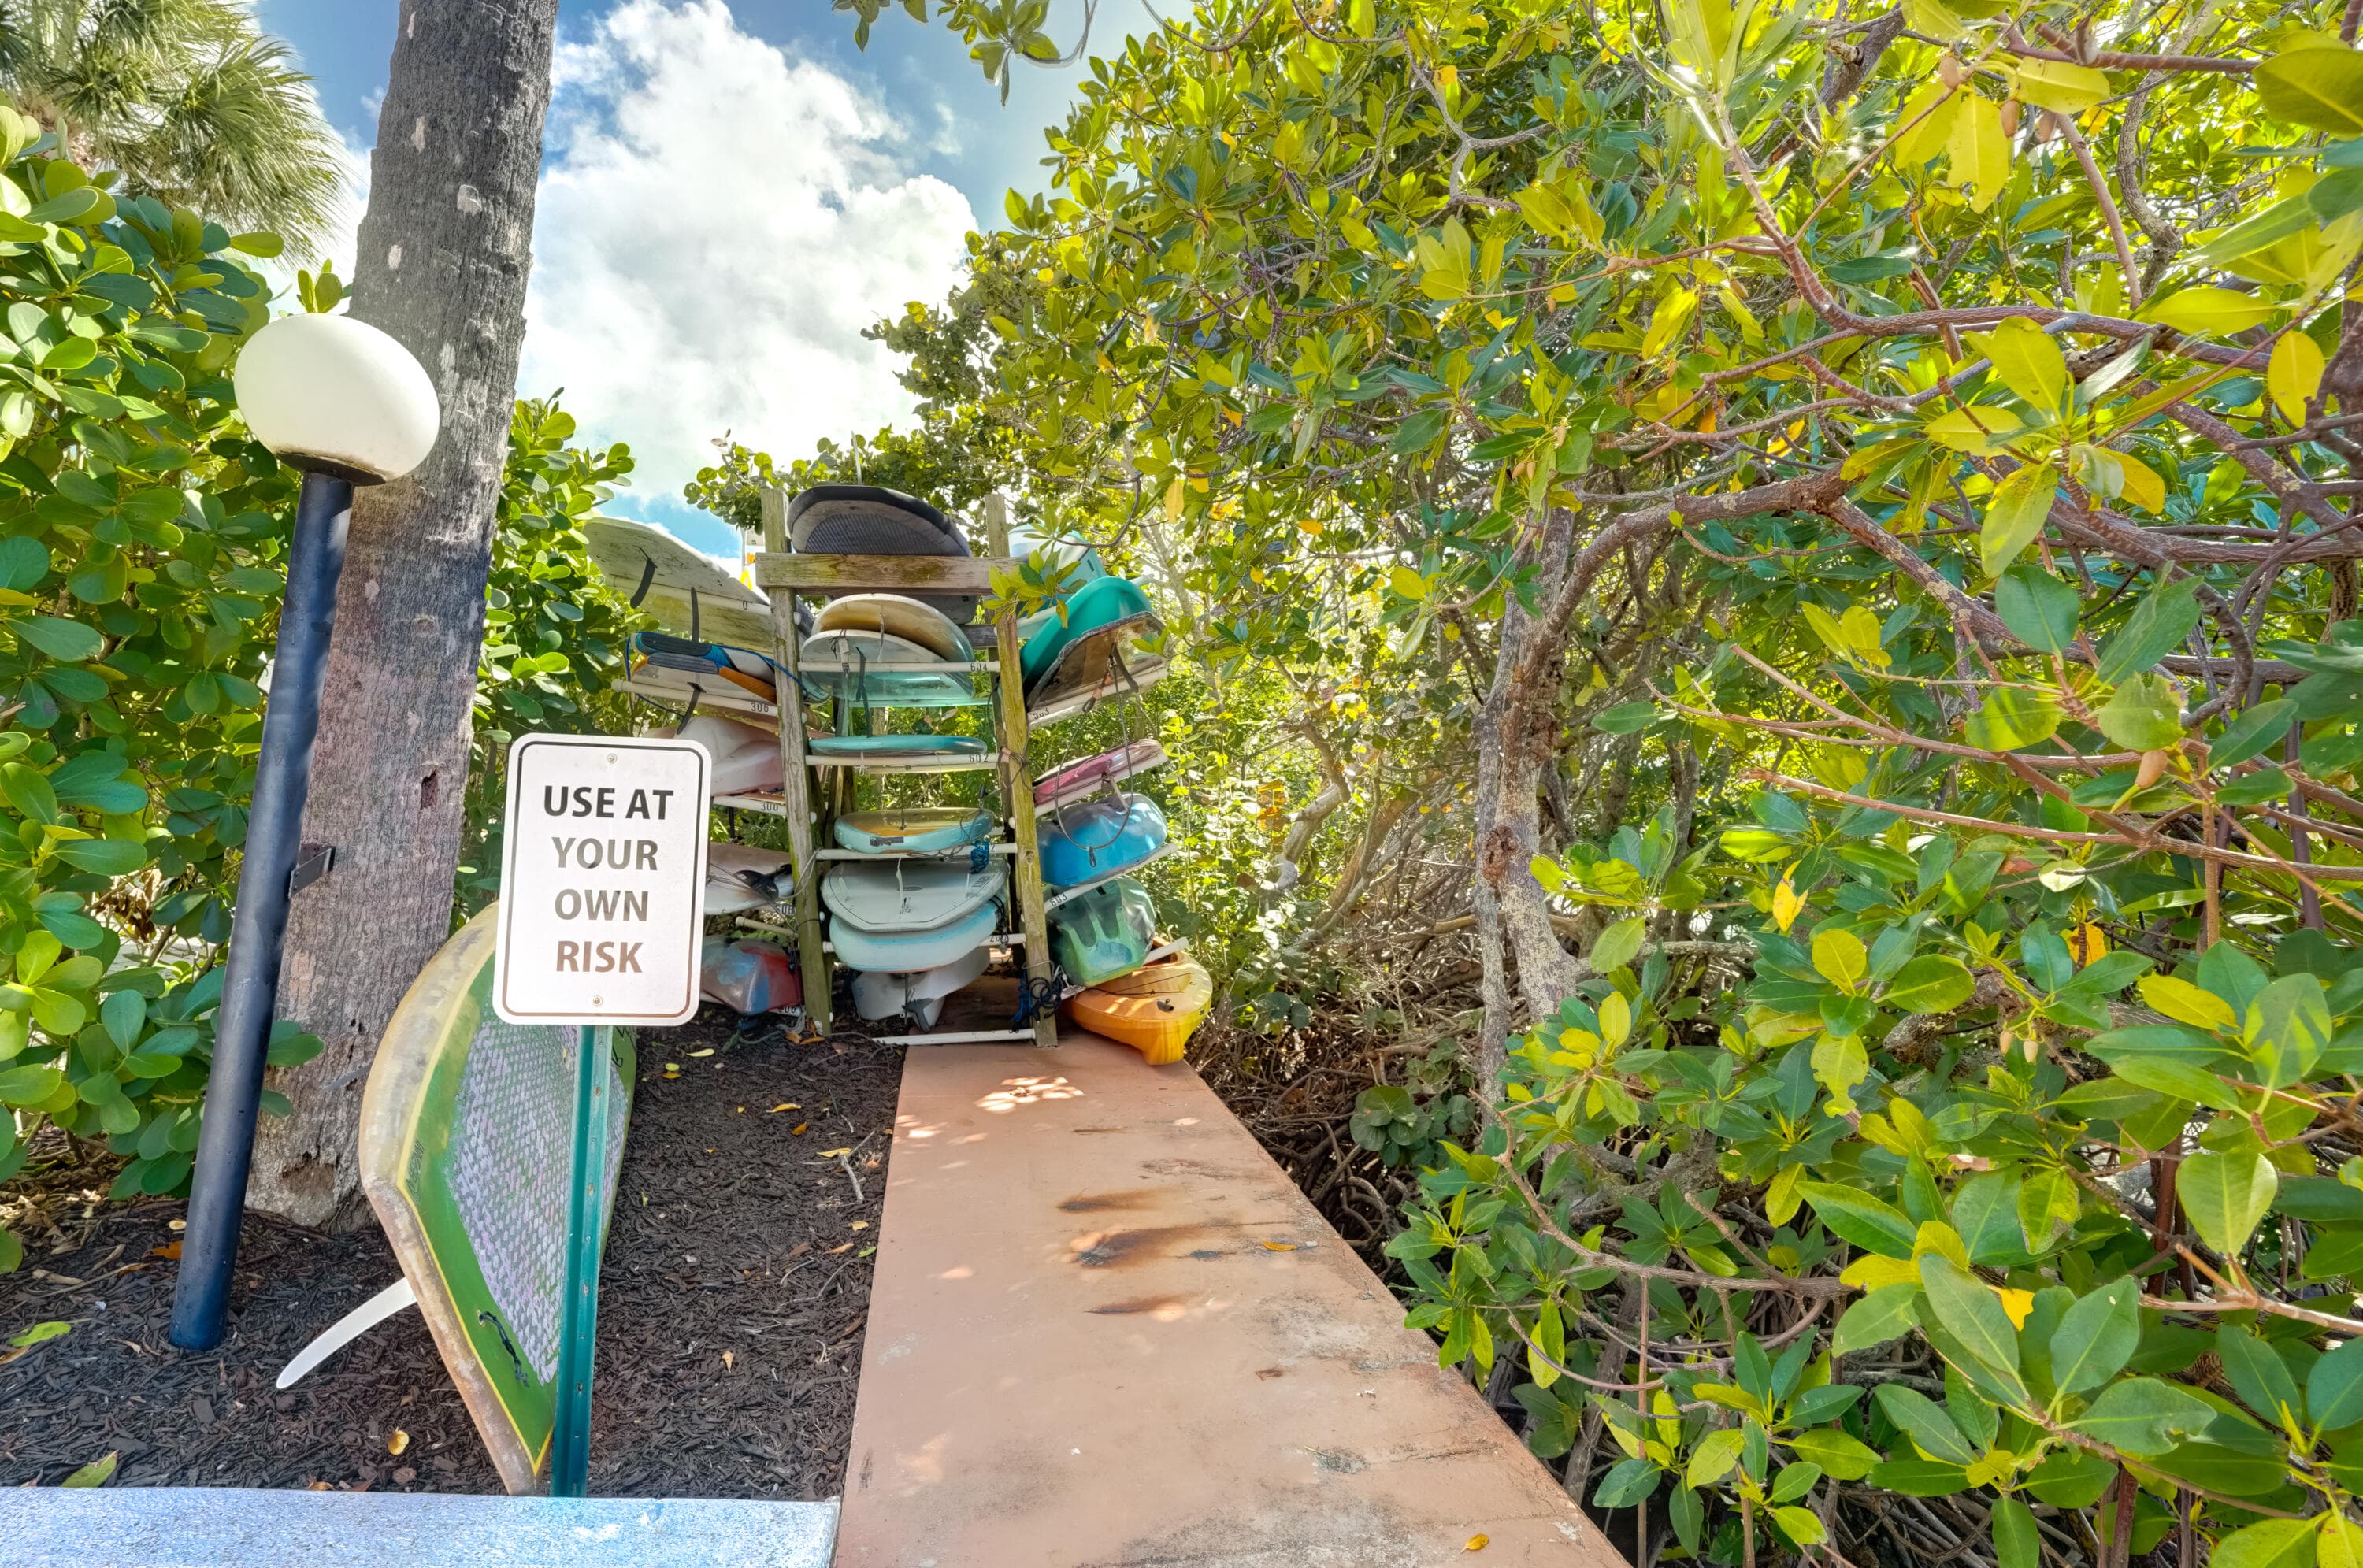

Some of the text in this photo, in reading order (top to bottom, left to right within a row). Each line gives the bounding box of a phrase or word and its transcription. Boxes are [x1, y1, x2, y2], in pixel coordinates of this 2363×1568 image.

[970, 662, 988, 672] 604
[751, 702, 769, 713] 306
[970, 754, 989, 763] 602
[543, 785, 674, 820] USE AT
[761, 802, 779, 812] 306
[551, 836, 658, 871] YOUR
[555, 888, 649, 921] OWN
[1049, 892, 1067, 907] 603
[556, 940, 644, 973] RISK
